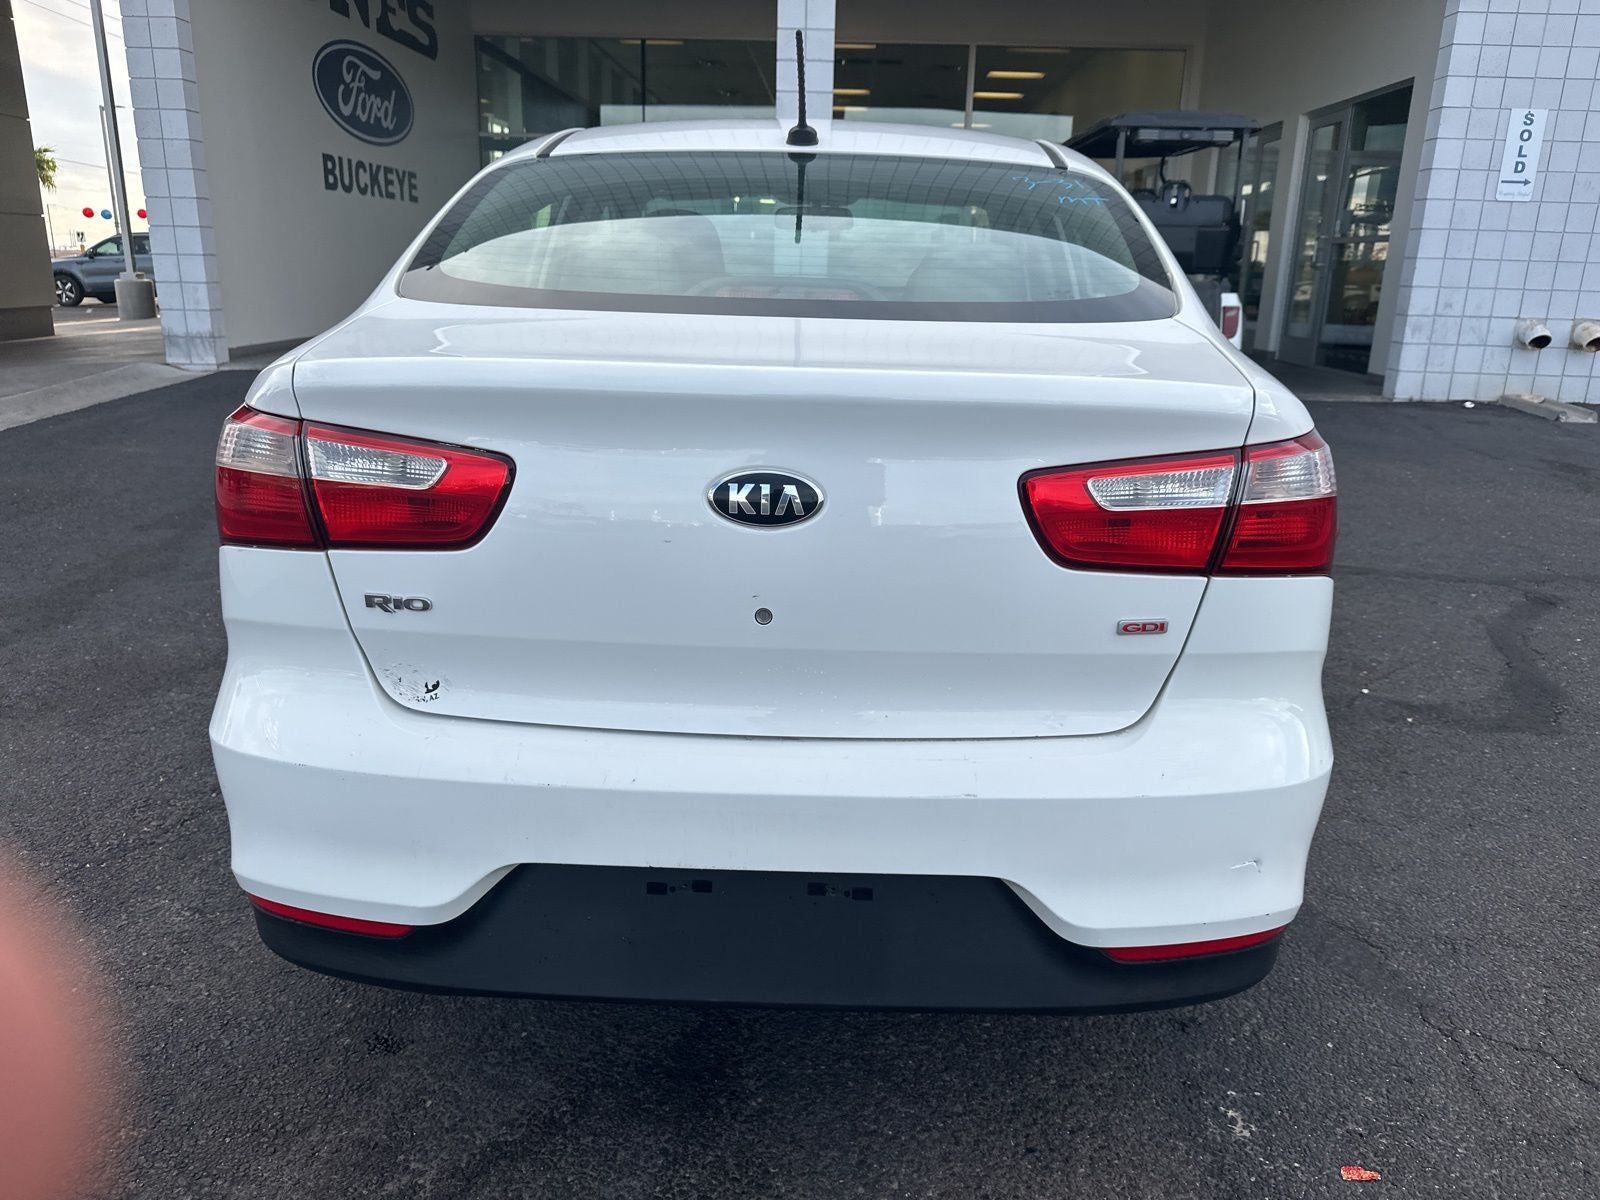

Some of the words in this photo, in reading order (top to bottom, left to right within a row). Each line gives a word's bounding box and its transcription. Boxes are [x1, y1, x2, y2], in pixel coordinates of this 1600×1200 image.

[337, 54, 397, 130] Ford
[1513, 110, 1535, 174] SOLD
[322, 152, 419, 203] BUCKEYE
[728, 482, 804, 516] KIA
[1122, 622, 1165, 633] GDI
